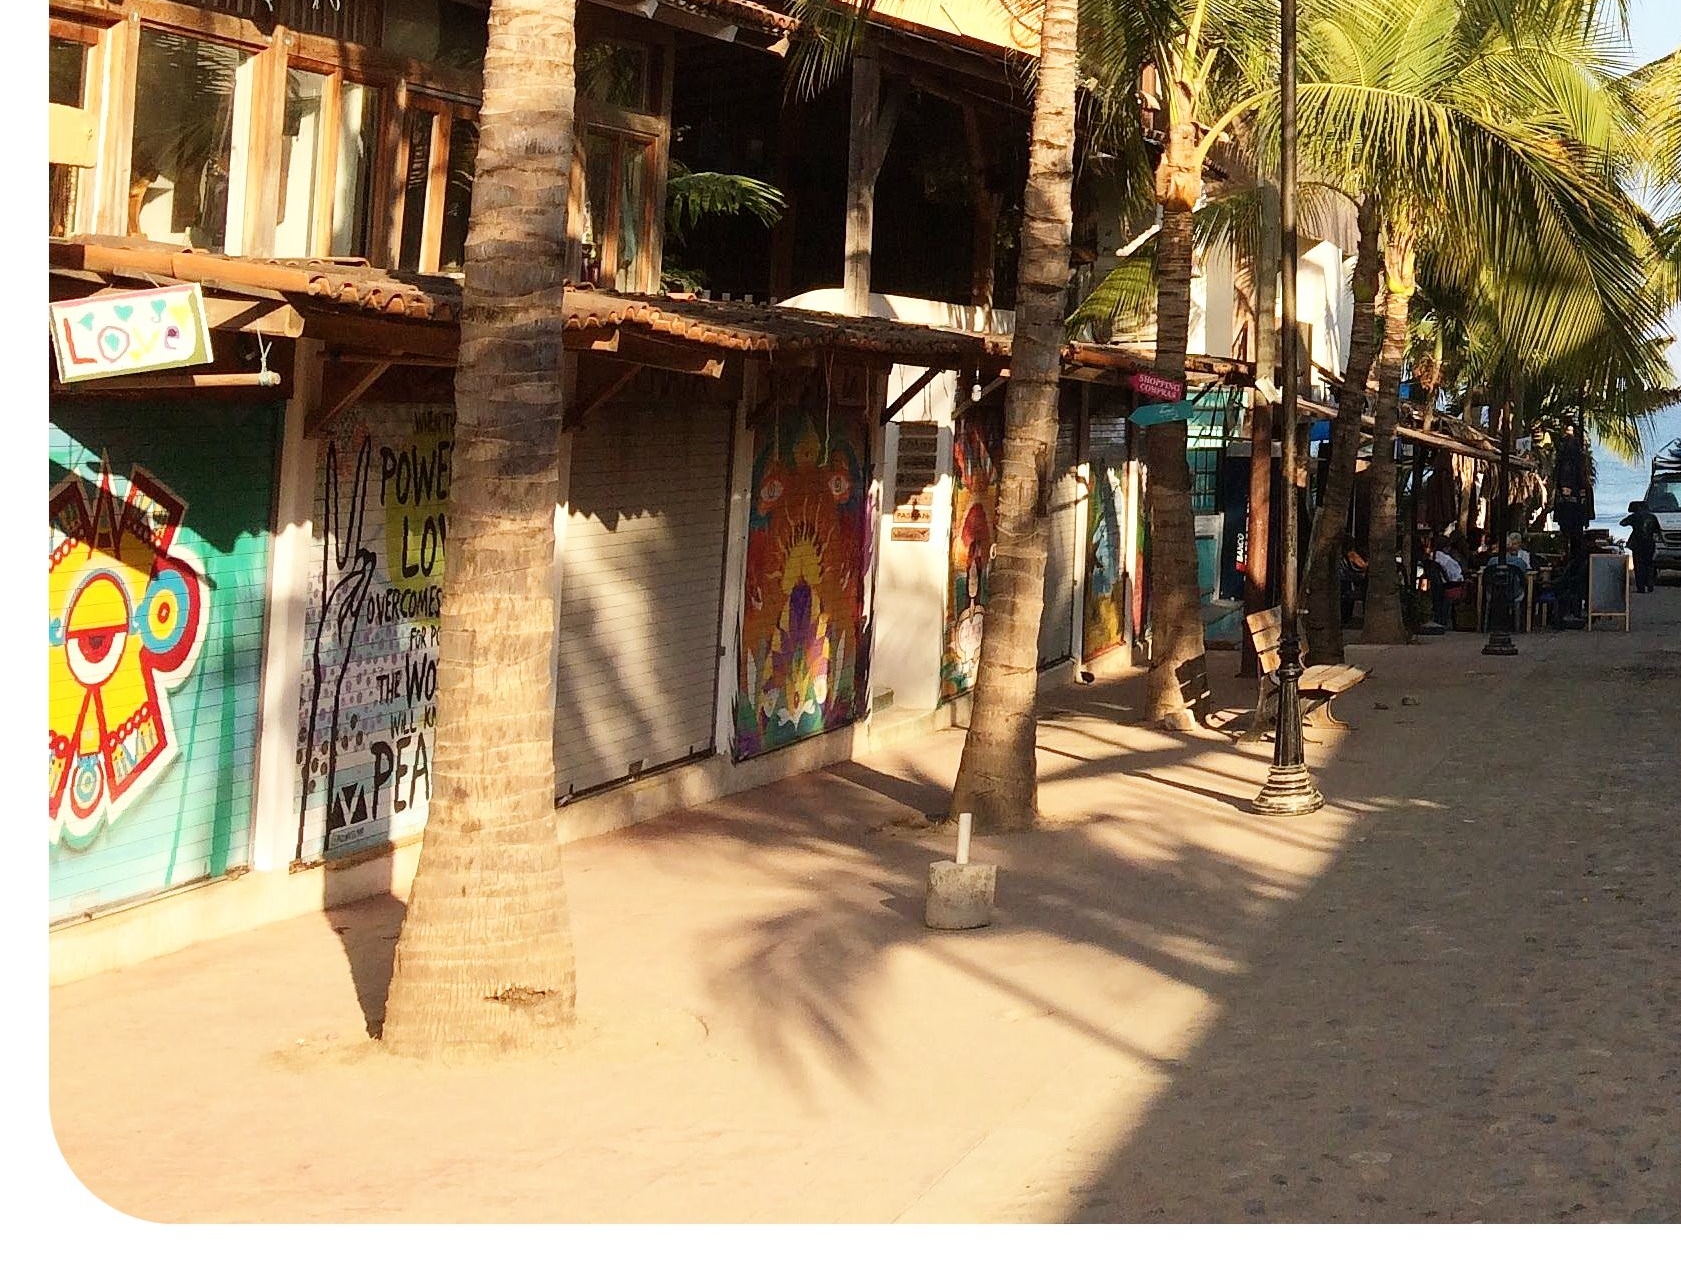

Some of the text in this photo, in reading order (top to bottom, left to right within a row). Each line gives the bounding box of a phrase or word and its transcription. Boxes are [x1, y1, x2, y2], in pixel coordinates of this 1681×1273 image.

[1138, 374, 1181, 392] SHOPPING
[1139, 382, 1178, 399] COMPRAS
[380, 440, 452, 507] POWE
[1235, 532, 1245, 563] BANCO
[366, 584, 443, 626] OVERCOMES
[410, 627, 427, 652] FOR
[376, 653, 440, 709] THE WO
[390, 705, 437, 740] WILL KN
[370, 732, 430, 821] PEA
